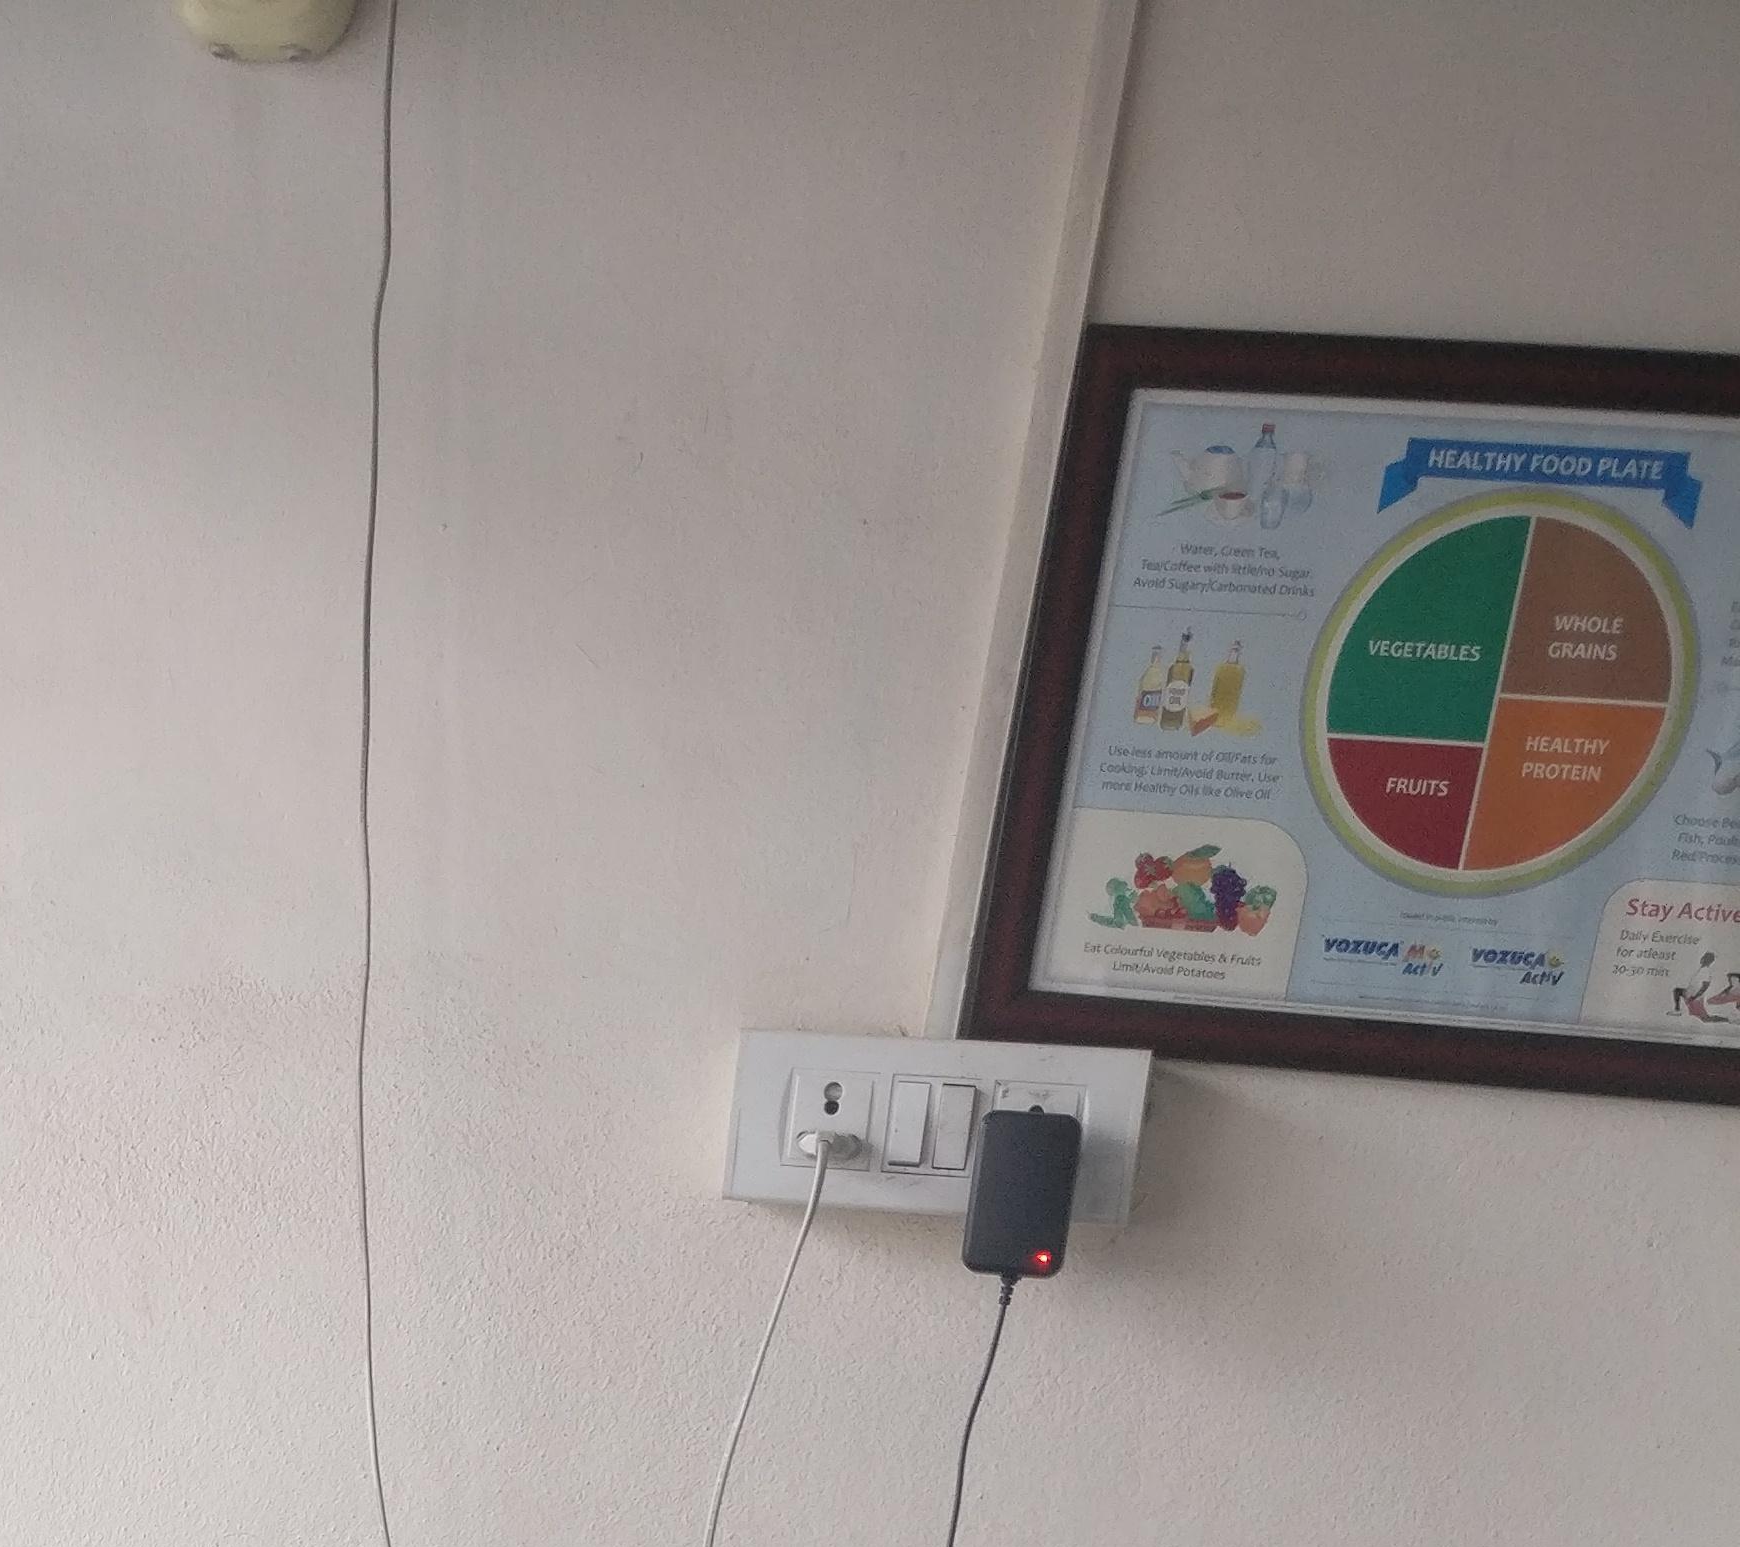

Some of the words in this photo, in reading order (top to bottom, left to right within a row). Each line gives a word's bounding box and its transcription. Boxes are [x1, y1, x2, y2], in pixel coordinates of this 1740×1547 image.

[1428, 447, 1528, 472] HEALTHY
[1530, 453, 1593, 476] FOOD
[1596, 457, 1665, 480] PLATE
[1554, 615, 1624, 635] WHOLE
[1368, 639, 1481, 662] VEGETABLES
[1547, 641, 1619, 661] GRAINS
[1525, 736, 1610, 755] HEALTHY
[1522, 762, 1602, 782] PROTEIN
[1385, 777, 1450, 797] FRUITS
[1626, 898, 1674, 923] Stay
[1084, 942, 1101, 954] Eat
[1104, 944, 1154, 957] Colourful
[1156, 949, 1216, 964] Vegetables
[1230, 955, 1261, 966] Fruits
[1323, 937, 1401, 960] VOZUCA
[1470, 947, 1547, 969] VOZUCA
[1112, 961, 1174, 976] Limit/Avoid
[1176, 966, 1226, 980] Potatoes
